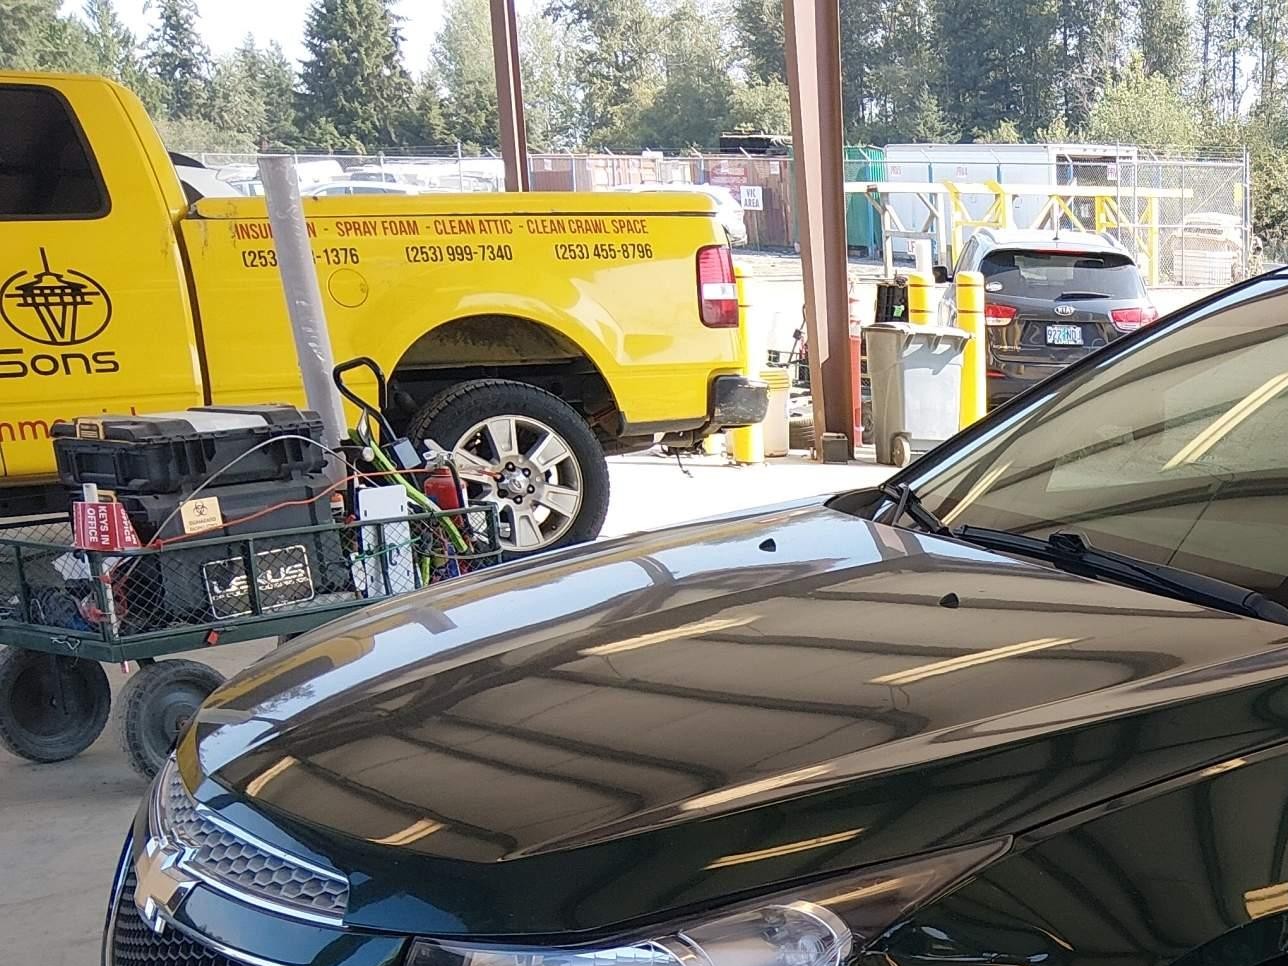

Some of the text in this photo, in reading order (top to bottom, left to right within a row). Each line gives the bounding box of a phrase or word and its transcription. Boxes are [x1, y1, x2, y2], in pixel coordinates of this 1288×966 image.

[743, 199, 760, 208] AREA
[234, 222, 317, 240] INSULN
[336, 220, 377, 237] SPRAY
[382, 220, 419, 236] FOAM
[434, 219, 476, 235] CLEAN
[478, 219, 513, 234] ATTIC
[527, 219, 566, 234] CLEAN
[568, 219, 609, 234] CRAWL
[612, 219, 649, 234] SPACE
[242, 249, 279, 268] (253
[405, 244, 513, 263] (253) 999-7340
[555, 243, 653, 260] (253) 455-8796
[1056, 305, 1074, 315] KIA
[0, 348, 120, 379] Sons
[86, 507, 99, 543] OFFICE
[97, 505, 111, 546] KEYS IN
